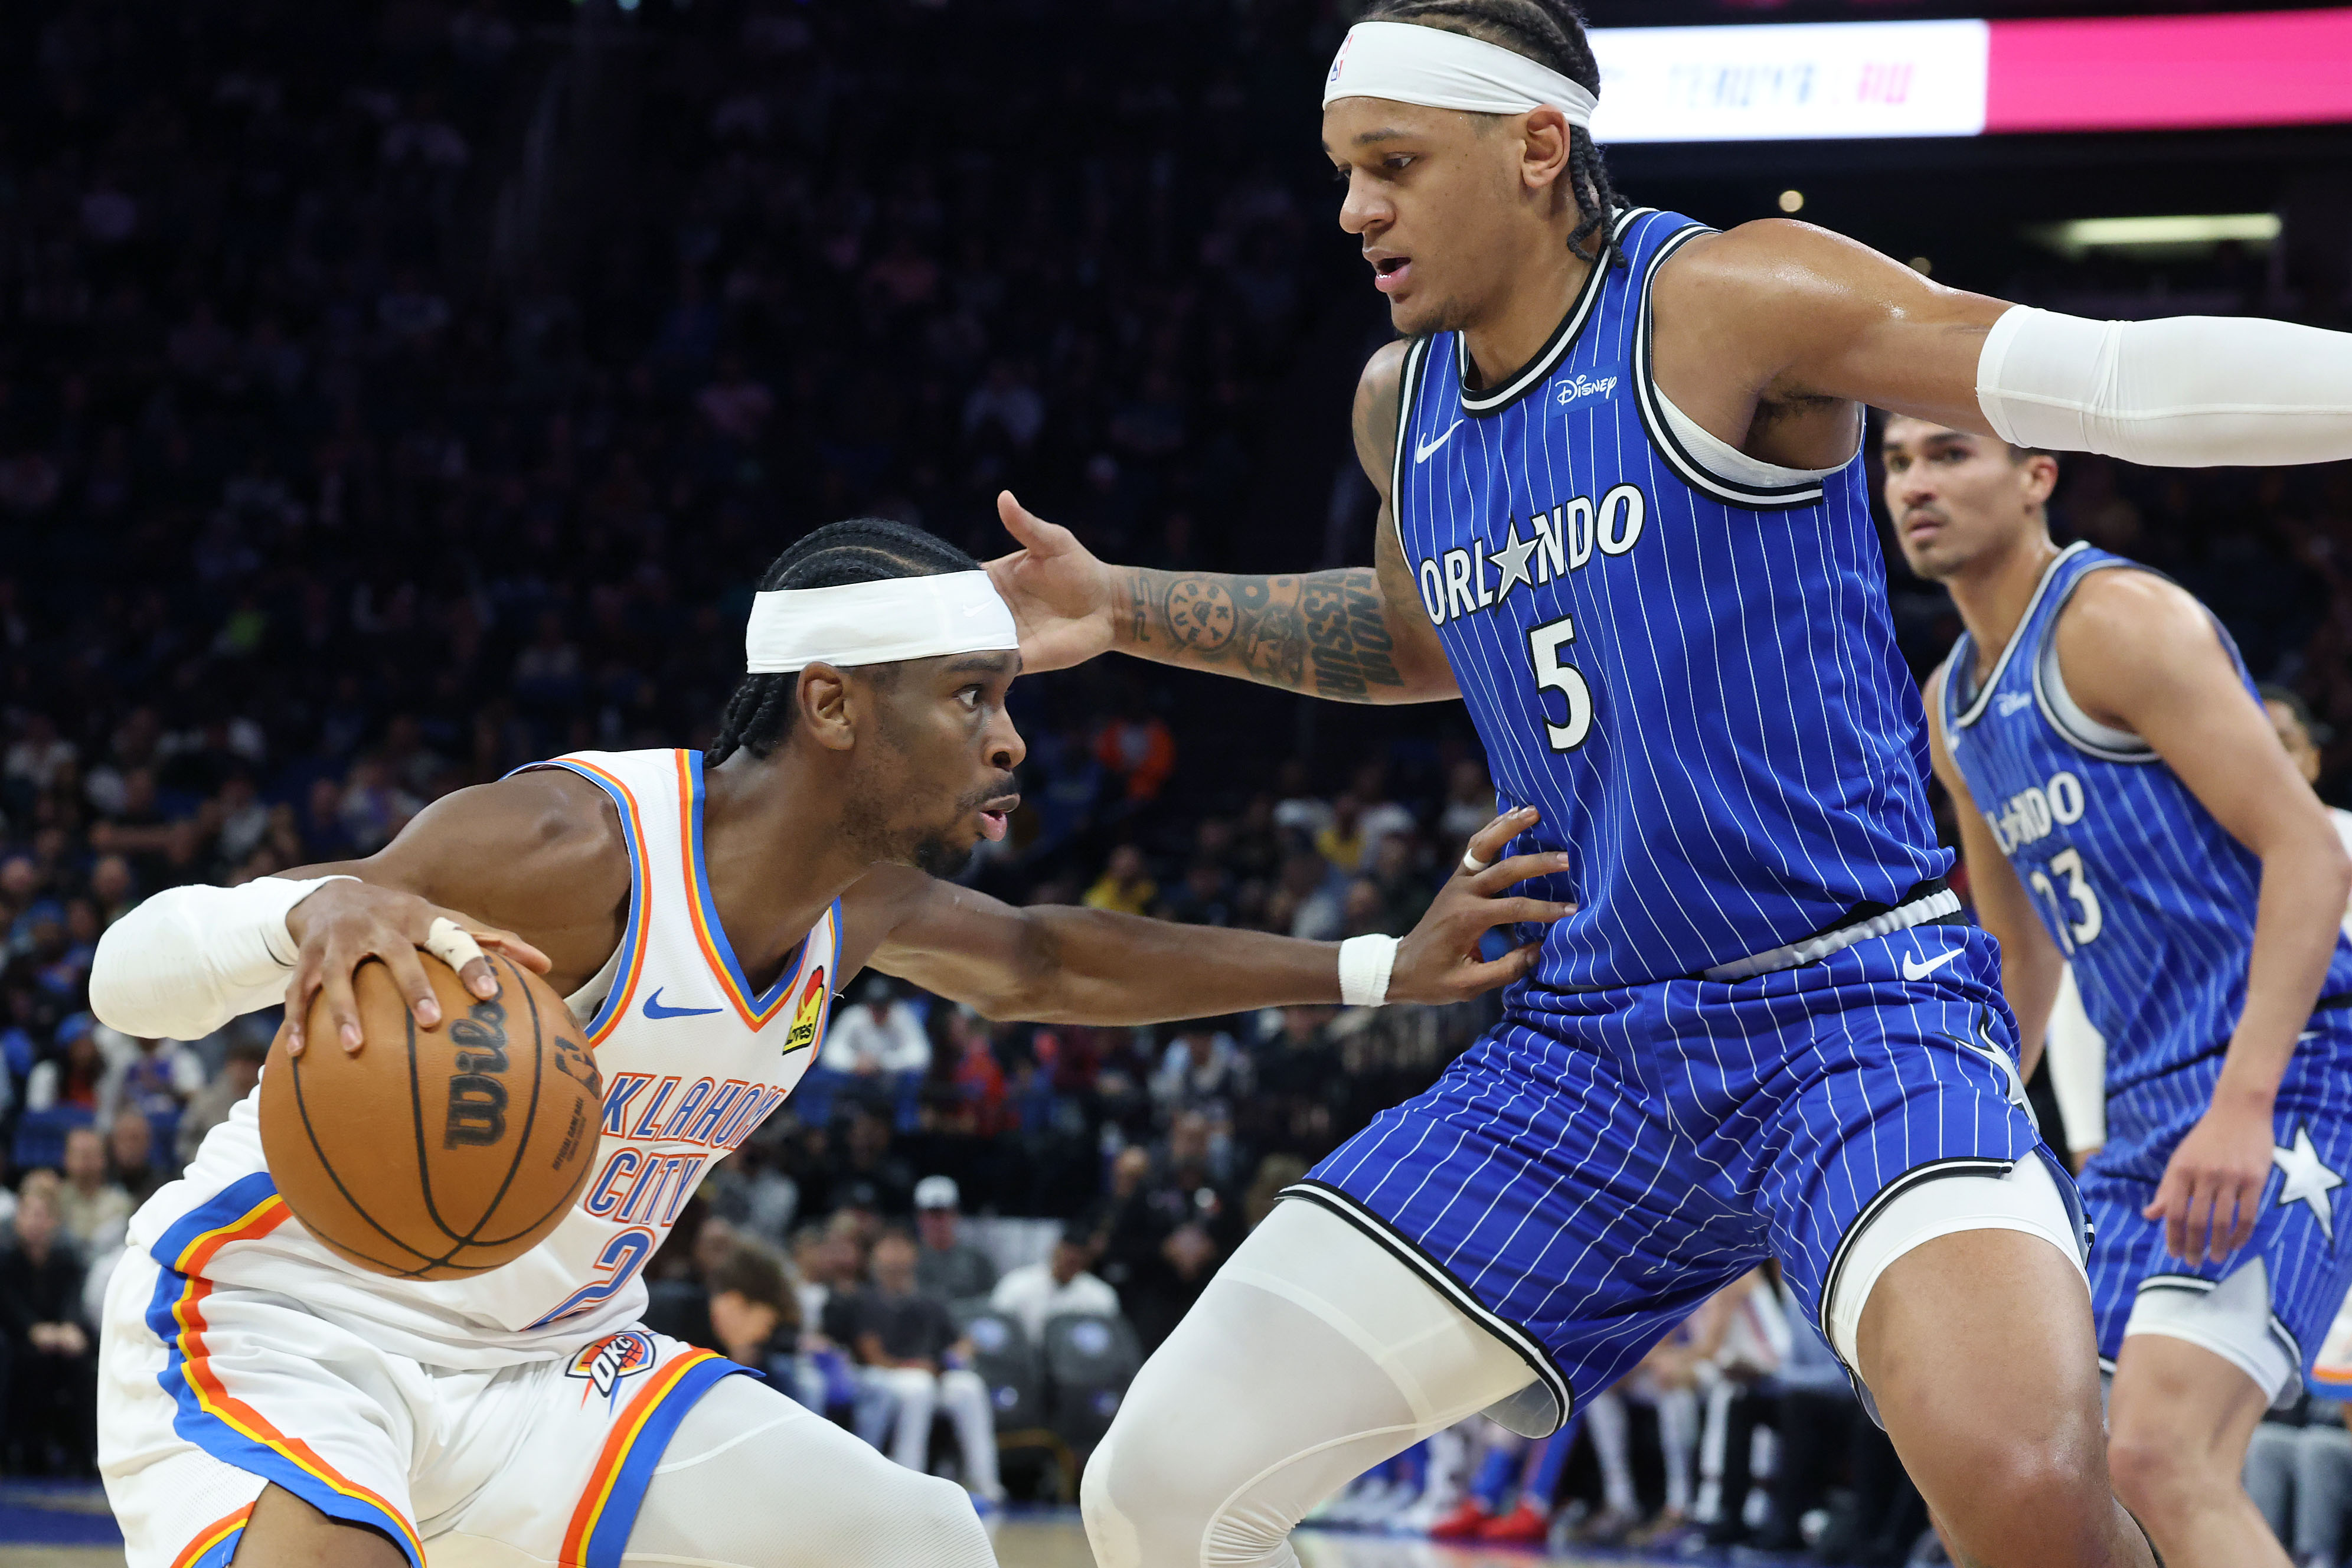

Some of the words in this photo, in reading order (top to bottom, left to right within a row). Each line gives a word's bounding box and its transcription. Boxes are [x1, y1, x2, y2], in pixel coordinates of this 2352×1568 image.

[1554, 374, 1618, 406] Disney
[1526, 612, 1594, 754] 5
[443, 955, 509, 1151] Wils
[601, 1072, 788, 1152] KLAHOM
[584, 1146, 709, 1227] CITY
[520, 1226, 656, 1332] 2
[590, 1335, 634, 1397] OKC
